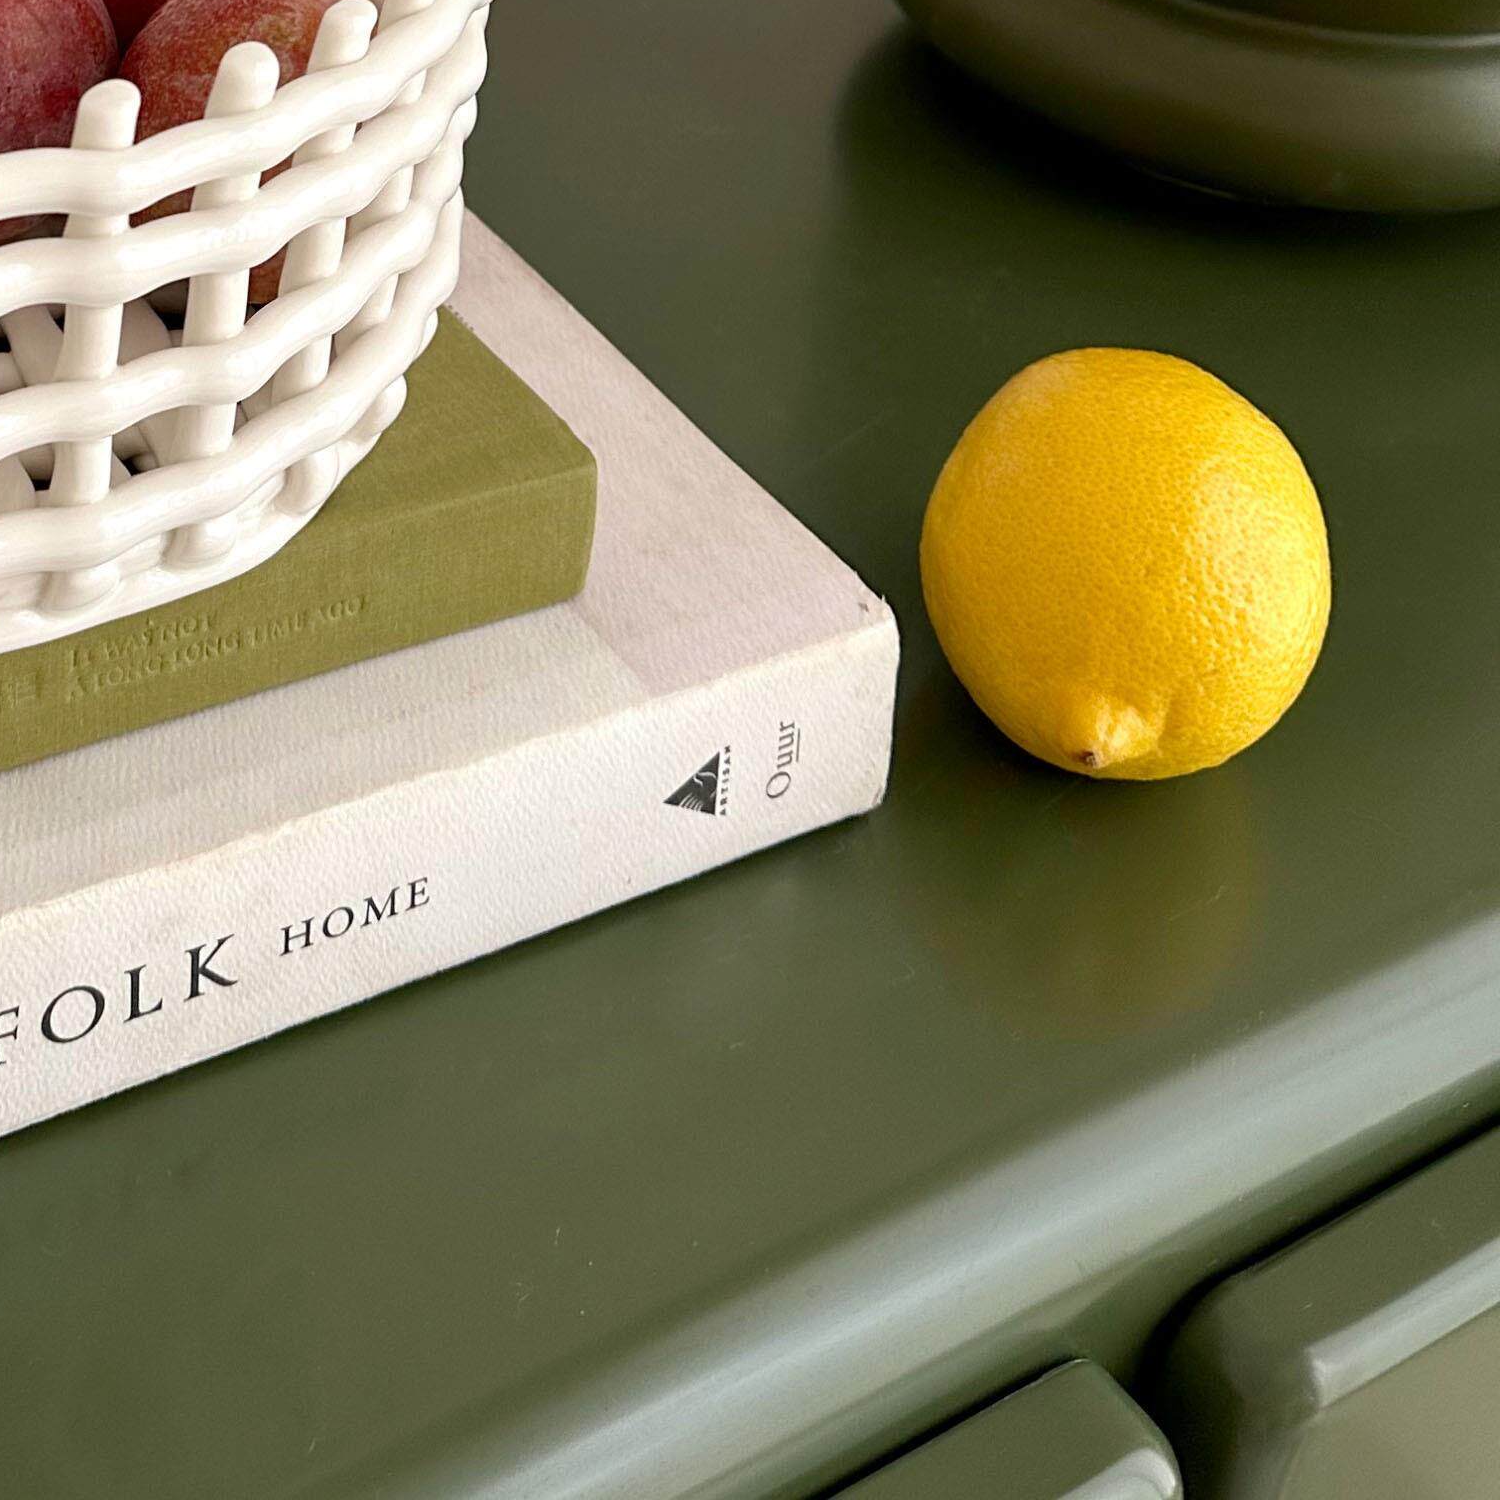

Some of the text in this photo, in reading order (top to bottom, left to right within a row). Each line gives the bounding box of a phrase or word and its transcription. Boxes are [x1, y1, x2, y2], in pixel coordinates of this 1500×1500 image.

[718, 744, 732, 817] ARTISAN
[765, 720, 798, 800] Ouur
[278, 876, 432, 958] HOME
